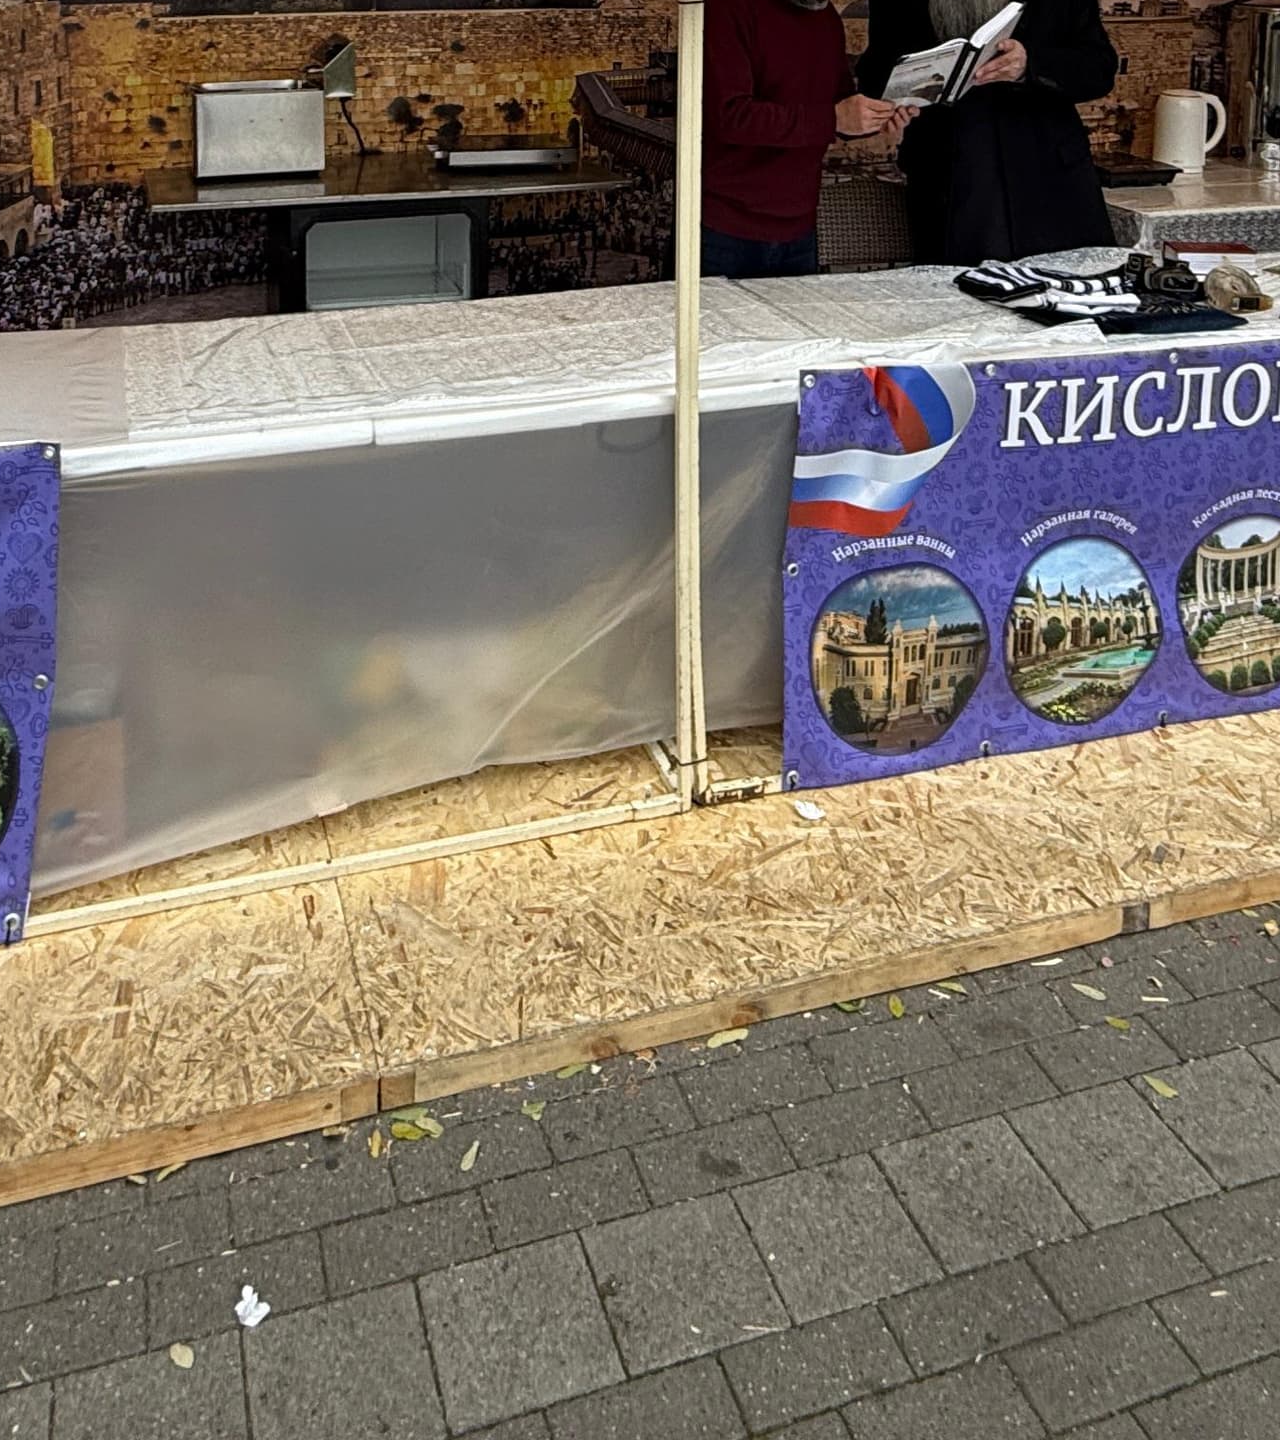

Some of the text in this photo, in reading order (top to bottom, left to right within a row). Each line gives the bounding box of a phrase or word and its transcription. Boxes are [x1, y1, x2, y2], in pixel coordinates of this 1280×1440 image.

[1020, 509, 1139, 547] Нарзанная галерея
[1192, 490, 1253, 528] Каскадная
[831, 535, 957, 563] Нарзанные ванны
